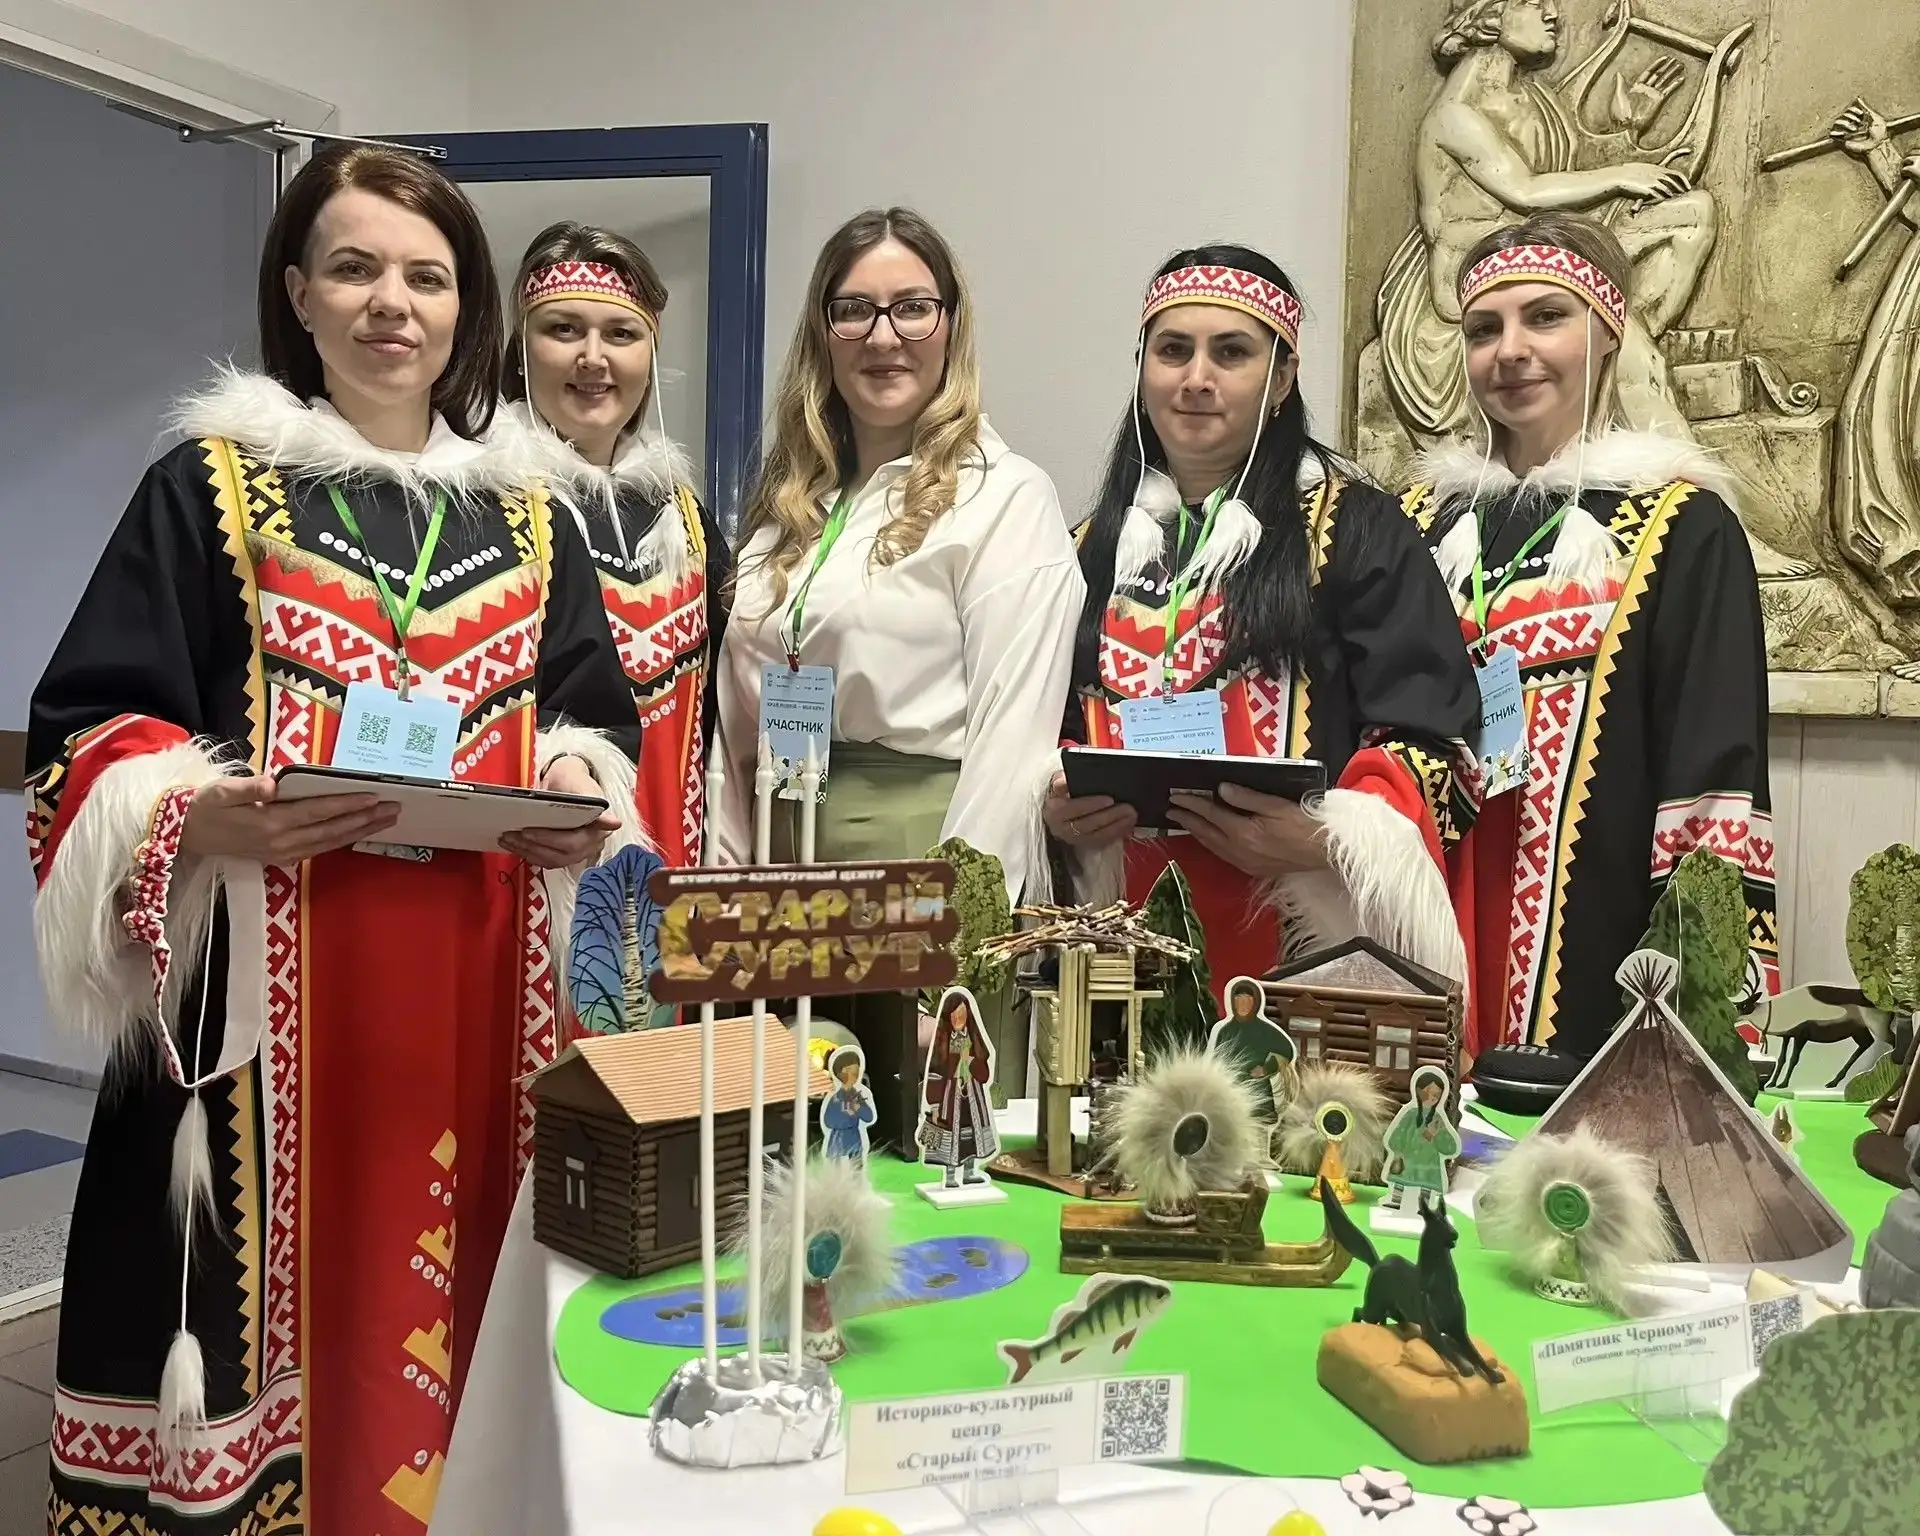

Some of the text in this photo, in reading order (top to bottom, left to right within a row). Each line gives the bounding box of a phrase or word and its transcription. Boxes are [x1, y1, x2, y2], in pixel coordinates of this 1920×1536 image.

[766, 717, 824, 734] УЧАСТНИК
[1478, 702, 1518, 730] АСТНИК
[1493, 1043, 1560, 1059] JBL
[1537, 1313, 1740, 1360] «Памятник Черному лису»
[876, 1386, 1074, 1423] Историко-культурный
[951, 1423, 1002, 1440] центр
[896, 1445, 977, 1471] «Старый
